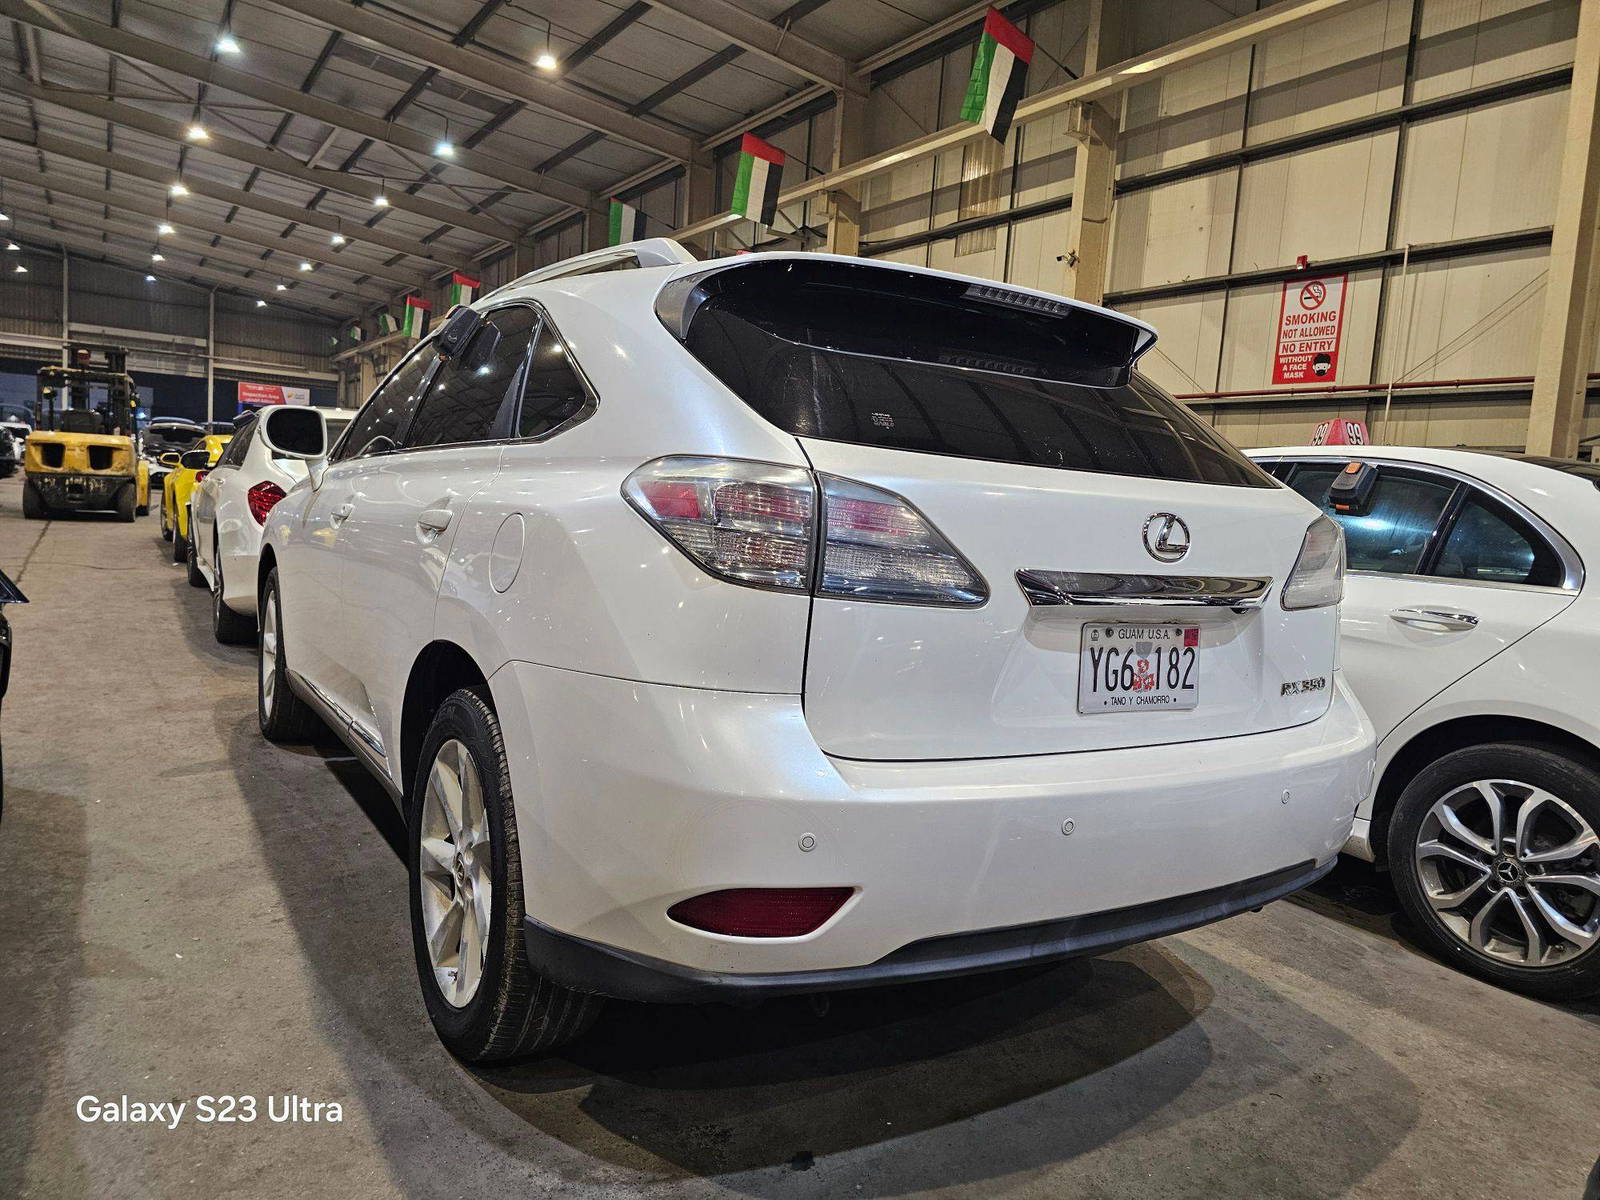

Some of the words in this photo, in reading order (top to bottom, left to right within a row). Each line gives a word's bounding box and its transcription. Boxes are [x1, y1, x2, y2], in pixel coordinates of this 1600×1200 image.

[1285, 311, 1336, 326] SMOKING
[1282, 328, 1298, 339] NOT
[1299, 325, 1336, 338] ALLOWED
[1281, 343, 1296, 353] NO
[1298, 340, 1334, 352] ENTRY
[1280, 355, 1312, 364] WITHOUT
[1289, 363, 1307, 371] FACE
[1283, 371, 1304, 379] MASK
[1346, 422, 1364, 445] 99
[1118, 628, 1144, 640] GUAM
[1148, 628, 1171, 640] U.S.A.
[1128, 696, 1134, 706] Y
[1136, 695, 1171, 706] CHAMORRO
